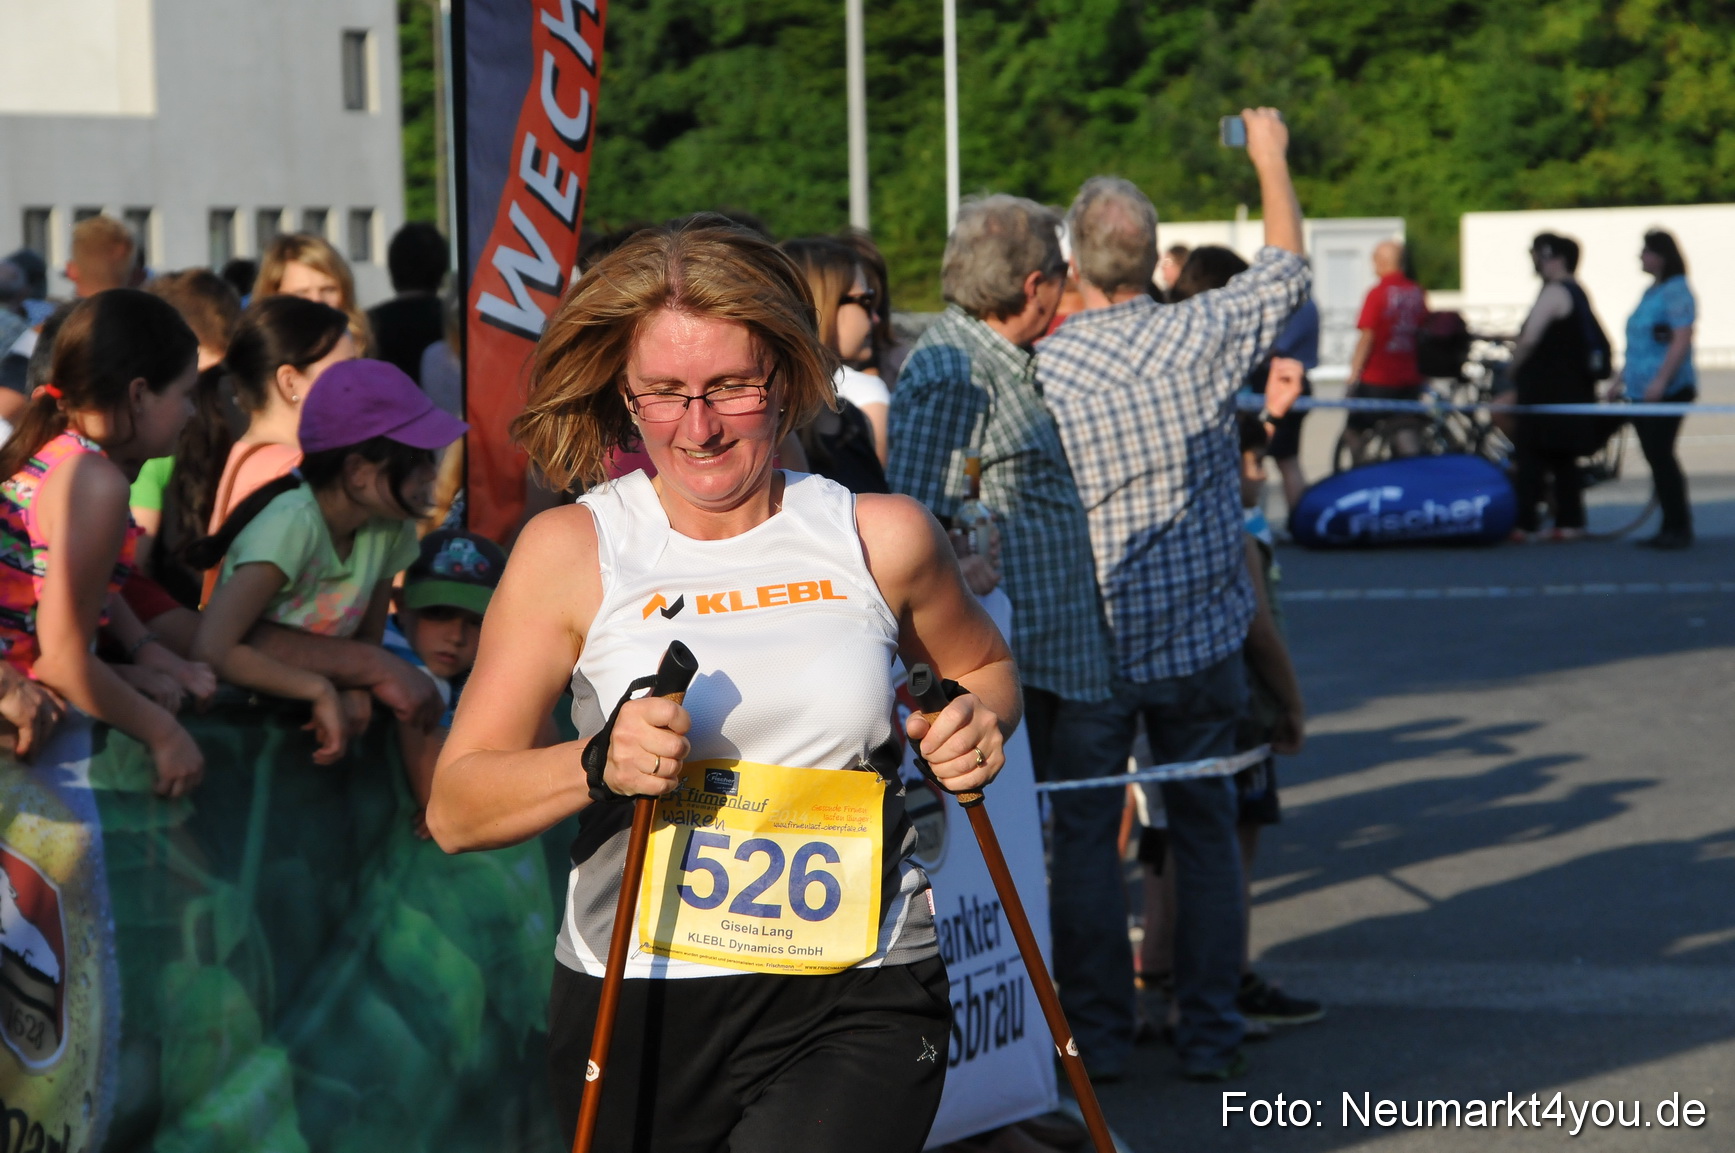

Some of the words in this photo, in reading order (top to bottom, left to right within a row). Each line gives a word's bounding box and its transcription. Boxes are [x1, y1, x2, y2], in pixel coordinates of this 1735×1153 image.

[1350, 495, 1491, 536] Fischer
[695, 579, 848, 615] KLEBL
[711, 774, 735, 785] Fischer
[687, 788, 769, 813] firmenlauf
[662, 809, 725, 831] walken
[768, 809, 809, 823] 2014
[677, 829, 841, 922] 526
[720, 920, 759, 936] Gisela
[761, 920, 793, 940] Lang
[936, 894, 1001, 966] arkter
[688, 932, 726, 948] KLEBL
[729, 939, 784, 956] Dynamics
[788, 945, 823, 956] GmbH
[6, 1001, 45, 1050] 1628
